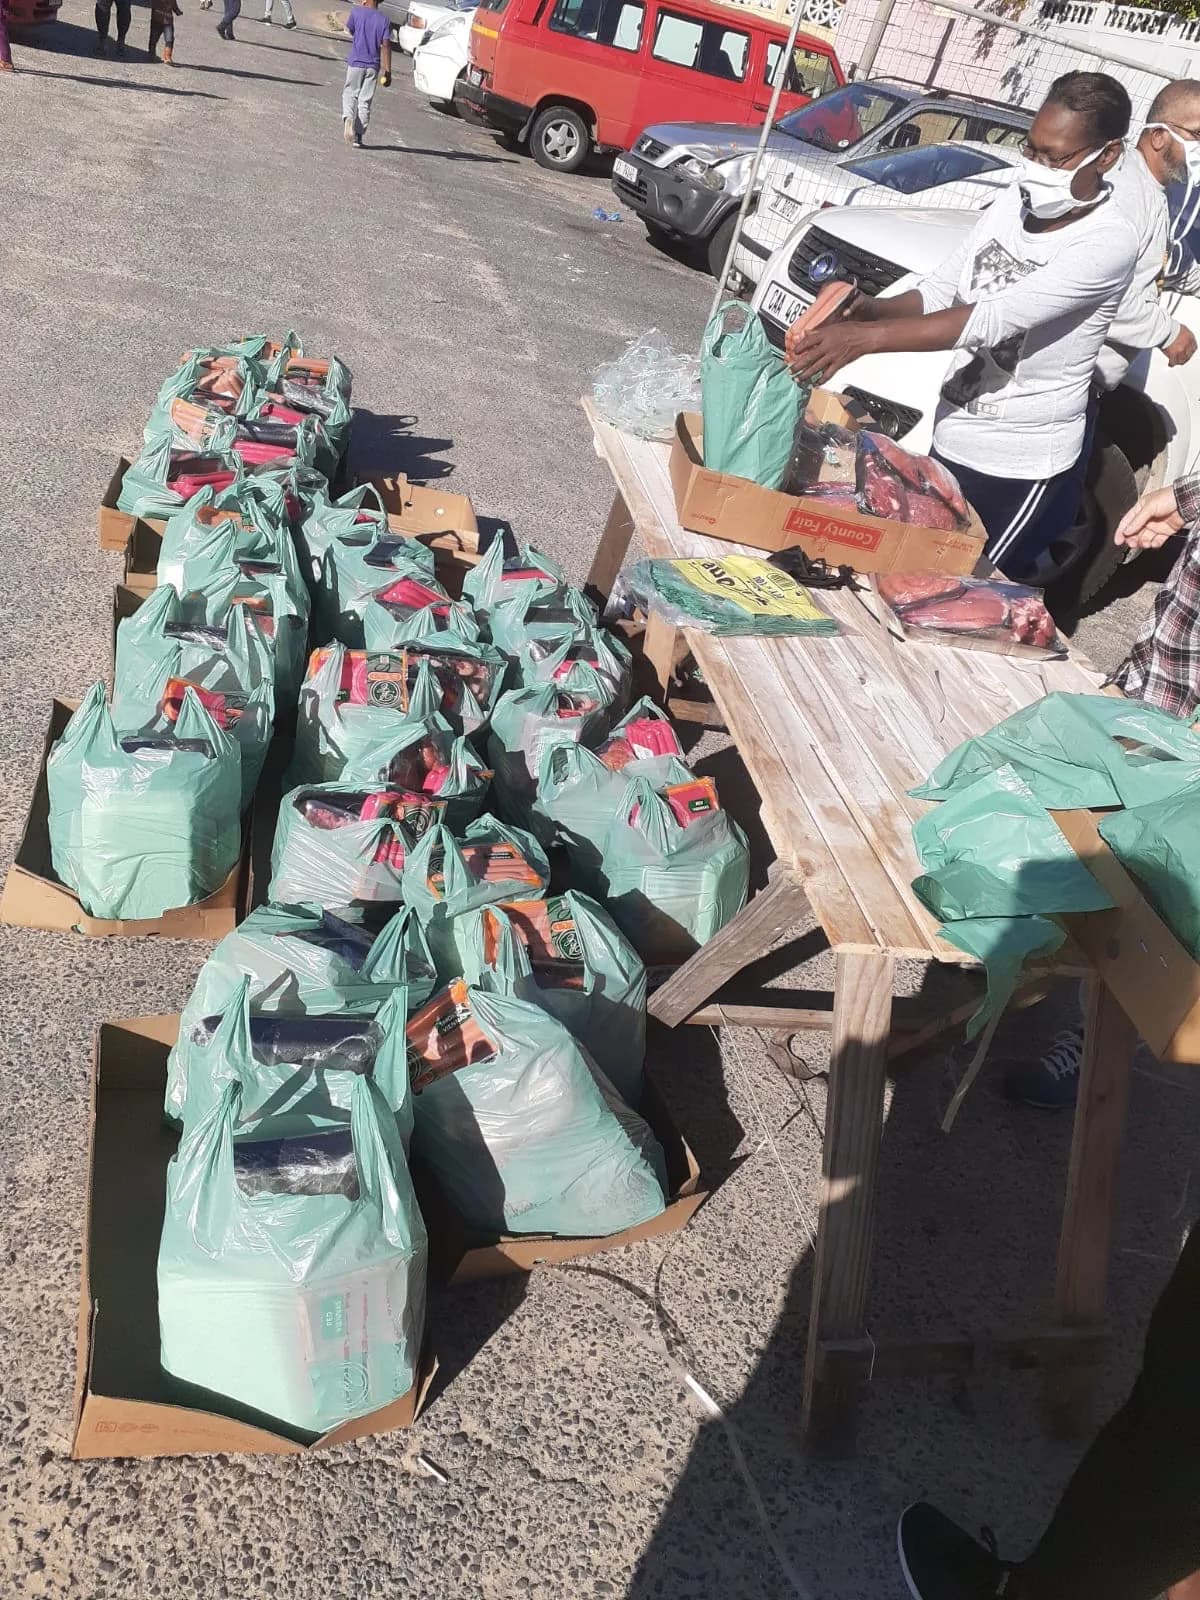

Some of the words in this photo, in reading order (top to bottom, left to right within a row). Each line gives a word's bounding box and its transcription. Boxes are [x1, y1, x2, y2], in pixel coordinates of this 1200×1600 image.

[768, 290, 787, 315] CAA
[793, 516, 820, 532] Fair
[823, 522, 873, 545] County
[701, 561, 736, 586] One
